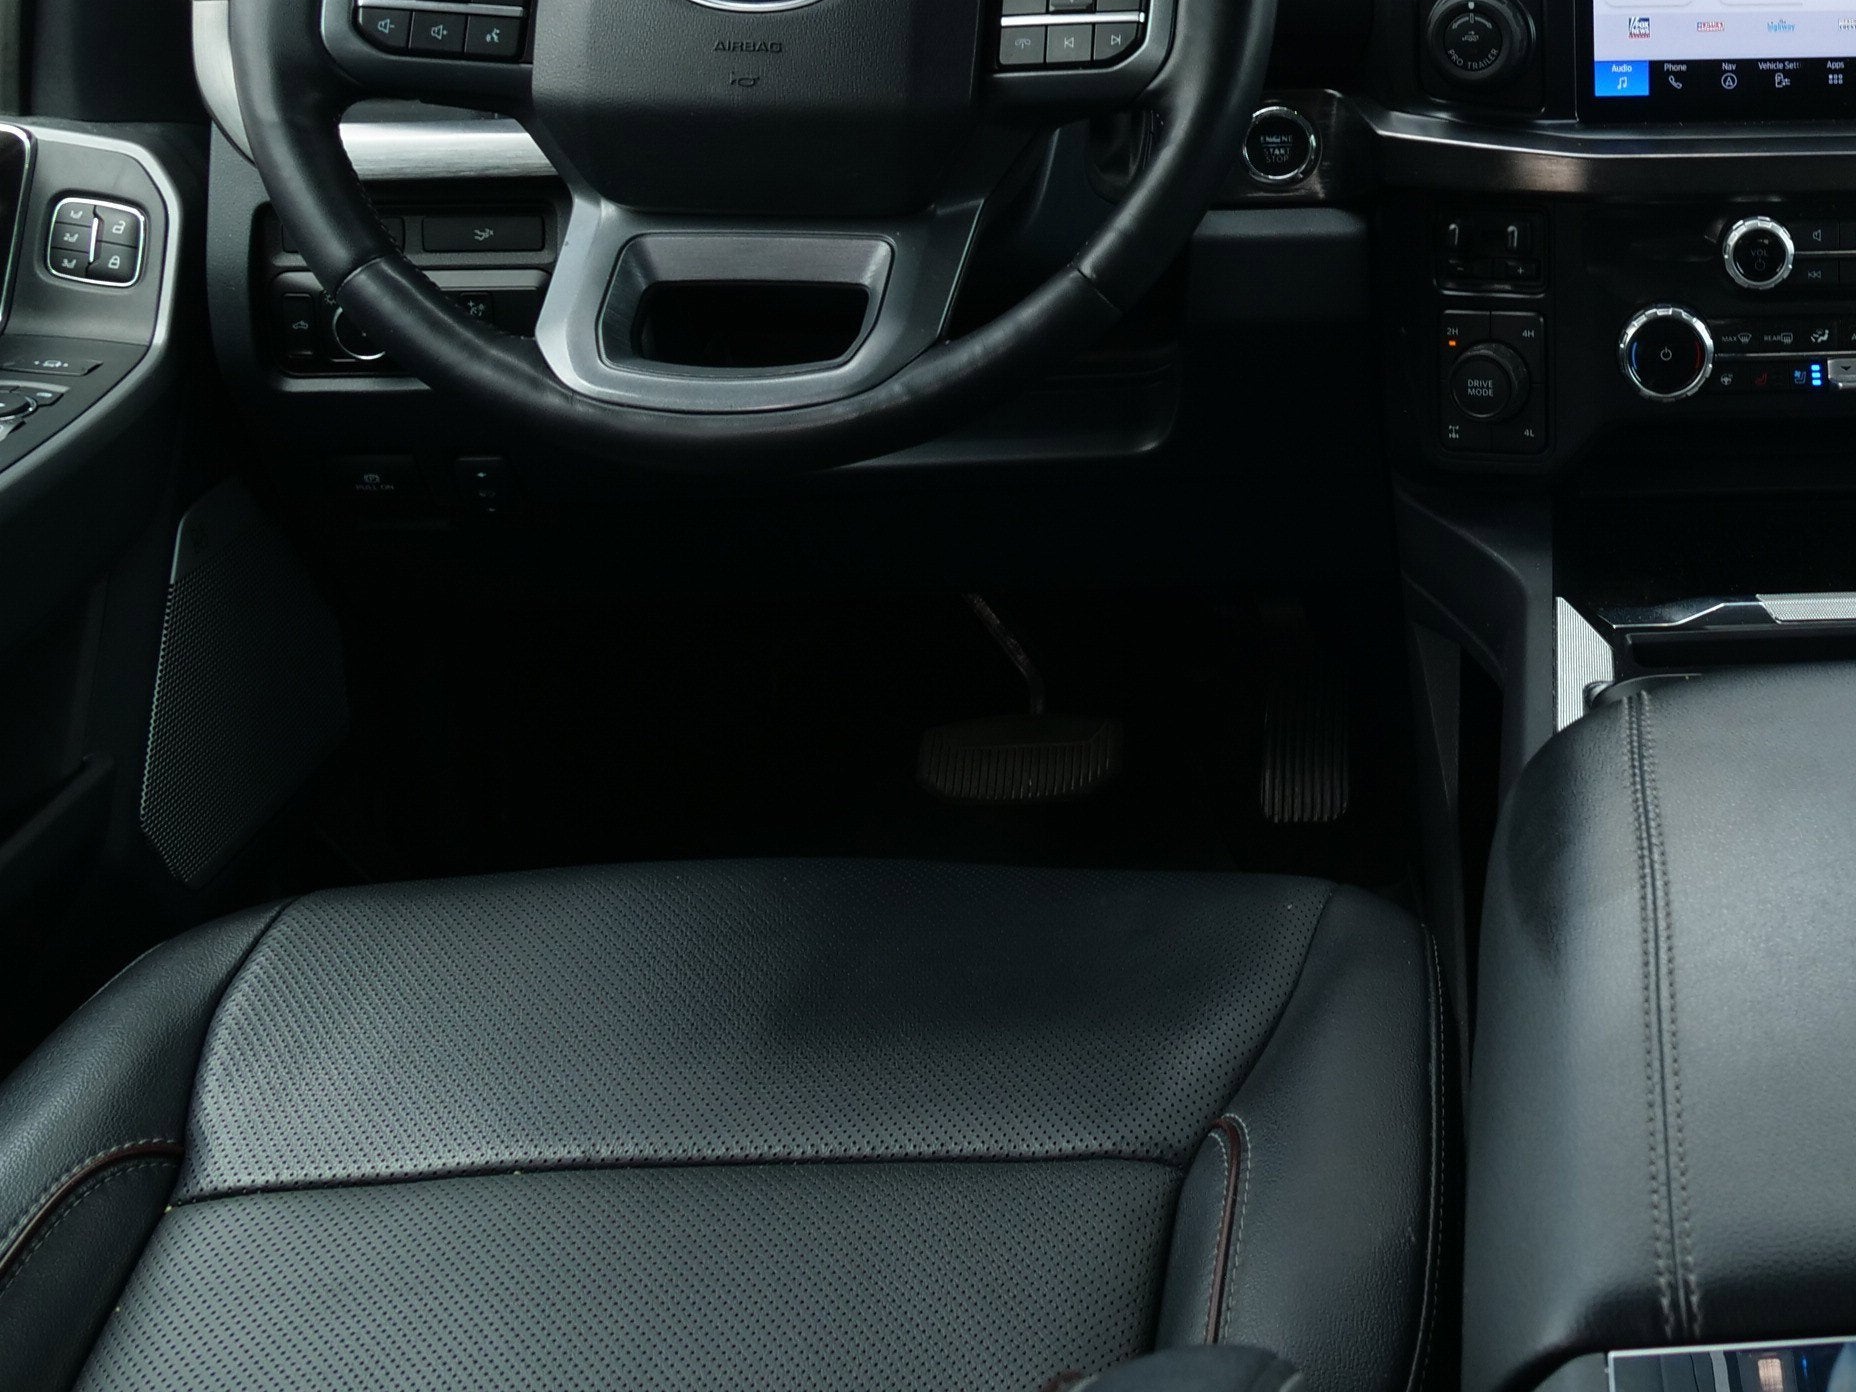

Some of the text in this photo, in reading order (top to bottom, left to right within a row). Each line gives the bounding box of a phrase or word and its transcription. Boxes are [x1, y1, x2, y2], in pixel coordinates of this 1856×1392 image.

[713, 40, 783, 53] AIRBAG
[1449, 48, 1499, 71] PRO TRAILER
[1611, 64, 1633, 73] Audio
[1664, 63, 1688, 72] Phone
[1722, 62, 1737, 71] Nav
[1758, 61, 1784, 71] Vehicle
[1826, 61, 1845, 71] Apps
[1263, 147, 1291, 156] START
[1265, 155, 1290, 164] STOP
[1446, 327, 1459, 336] 2H
[1522, 329, 1535, 338] 4H
[1722, 335, 1738, 343] MAX
[1467, 379, 1494, 389] DRIVE
[1467, 388, 1494, 397] MODE
[1523, 429, 1535, 438] 4L
